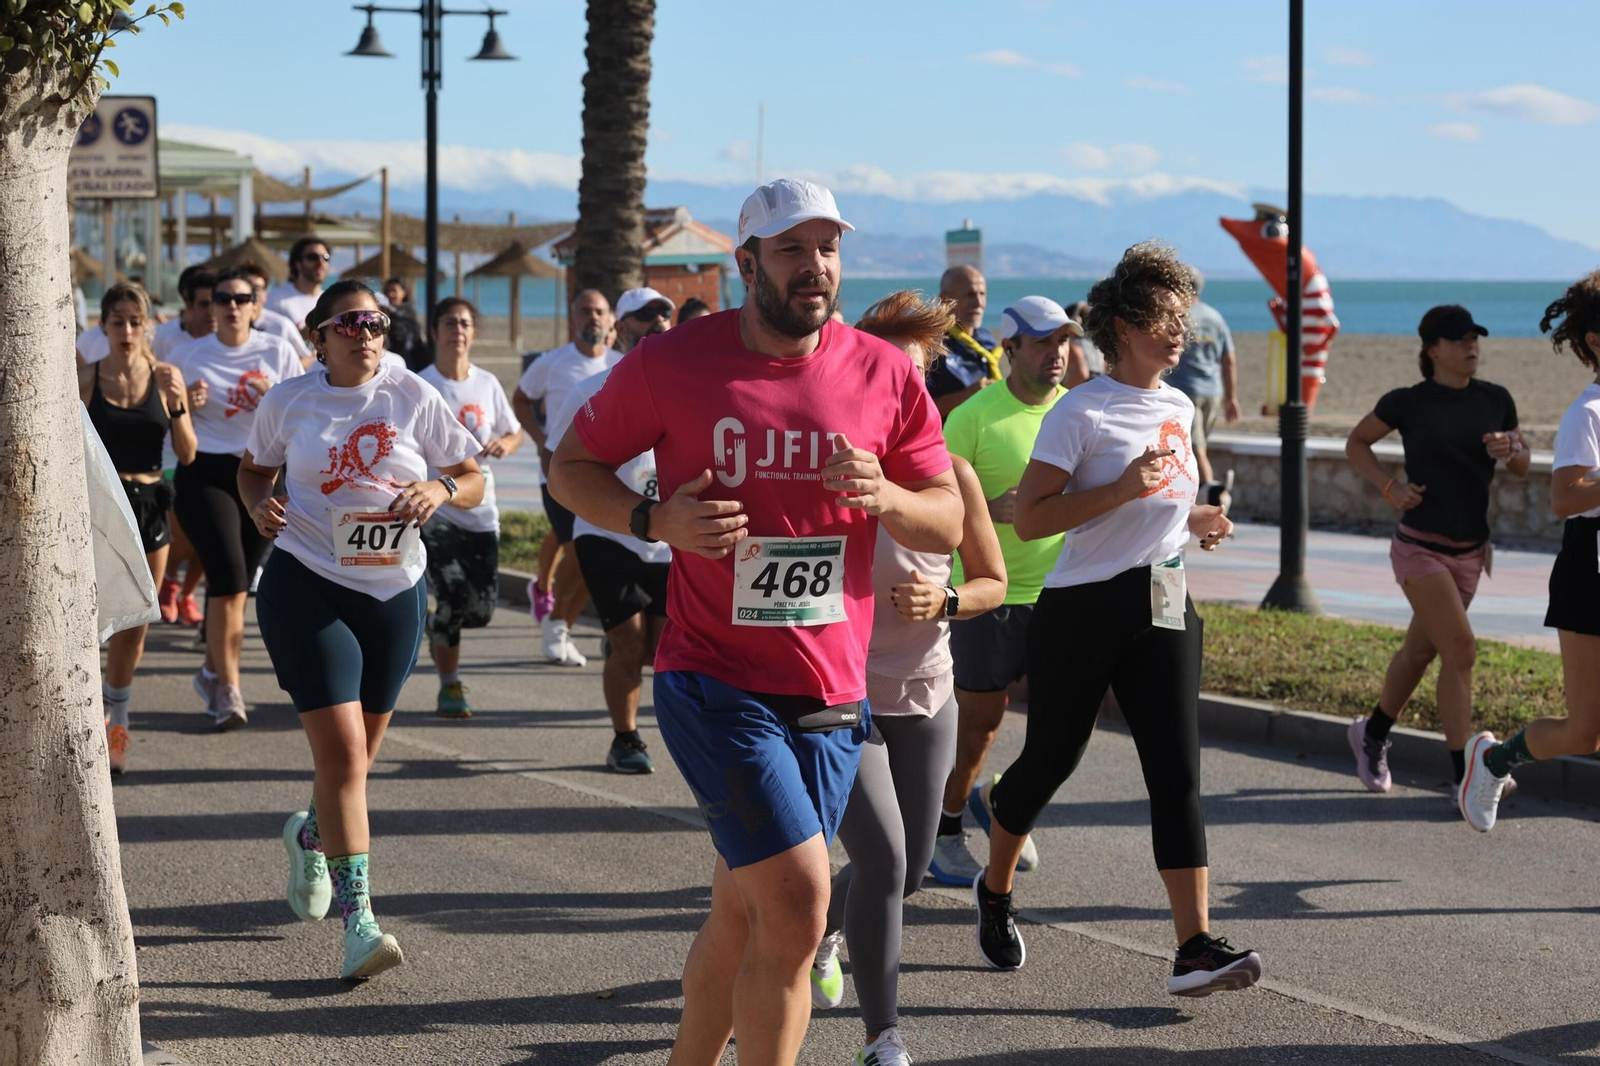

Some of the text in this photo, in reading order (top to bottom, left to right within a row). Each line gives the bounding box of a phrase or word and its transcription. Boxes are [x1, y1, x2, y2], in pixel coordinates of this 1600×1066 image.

[73, 181, 155, 191] EÑALIZADO
[755, 471, 791, 480] FUNCTIONAL
[793, 472, 821, 481] TRAINING
[347, 523, 408, 550] 407
[750, 560, 833, 598] 468
[739, 609, 758, 619] 024
